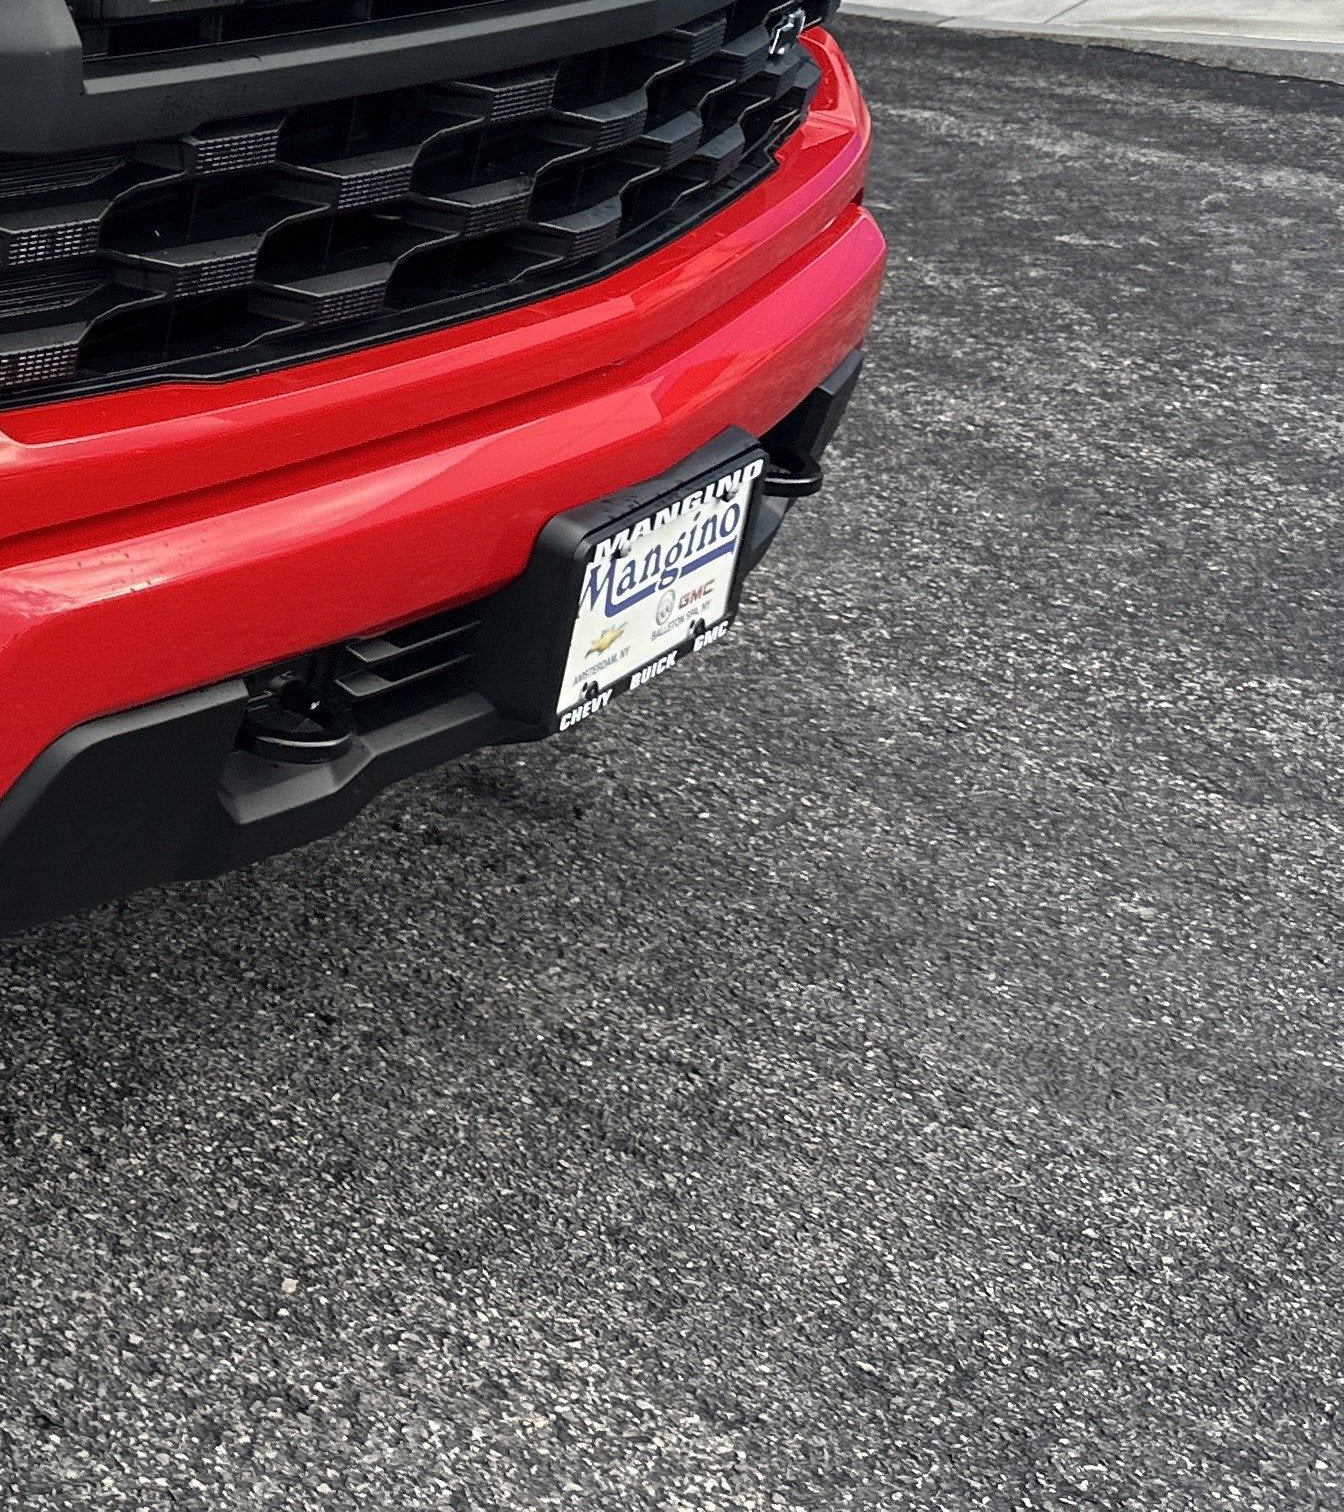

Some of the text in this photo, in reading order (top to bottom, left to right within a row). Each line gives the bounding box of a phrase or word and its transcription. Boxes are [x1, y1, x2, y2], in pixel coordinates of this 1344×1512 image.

[579, 502, 741, 617] Mangino
[593, 459, 764, 565] MANGINO
[678, 579, 715, 609] GMC
[559, 620, 729, 731] CHEVY BUICK GMC
